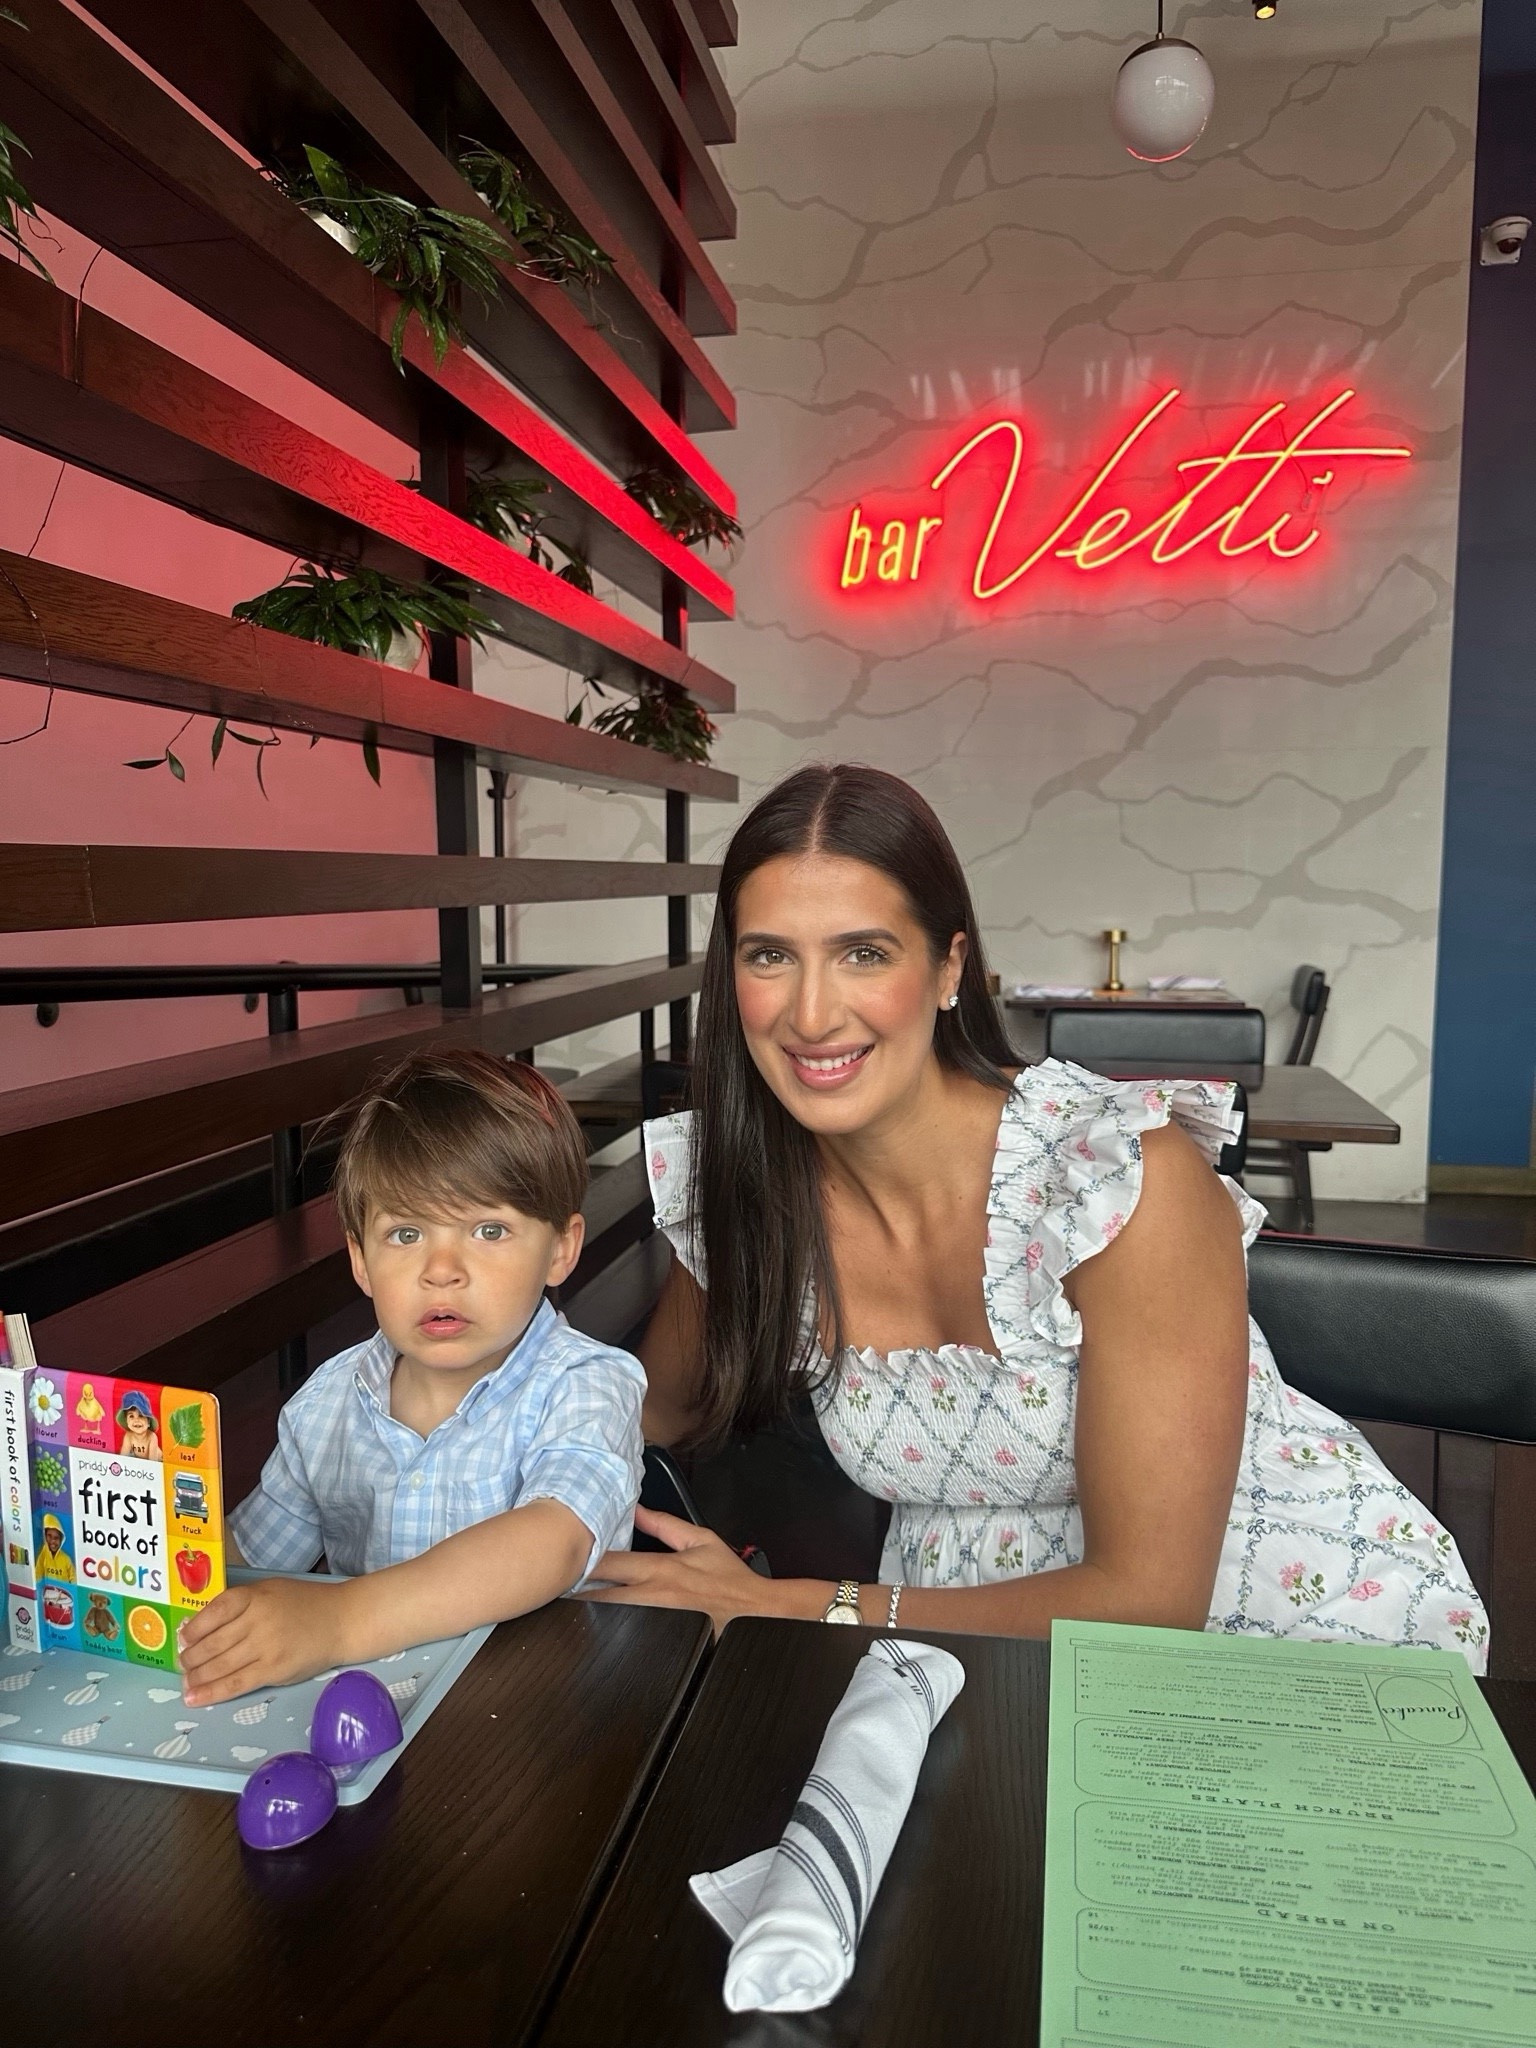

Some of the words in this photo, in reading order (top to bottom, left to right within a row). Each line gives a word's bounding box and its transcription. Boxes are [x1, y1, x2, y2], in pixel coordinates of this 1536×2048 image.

[841, 503, 941, 588] bar
[931, 389, 1411, 599] Vetti
[4, 1389, 16, 1424] first
[6, 1426, 20, 1463] book
[78, 1435, 107, 1448] duckling
[132, 1444, 146, 1453] hat
[180, 1452, 196, 1462] leaf
[9, 1465, 20, 1484] of
[79, 1460, 108, 1476] priddy
[124, 1465, 155, 1480] books
[10, 1486, 22, 1533] colors
[79, 1477, 157, 1527] first
[182, 1524, 202, 1535] truck
[82, 1520, 130, 1551] book
[136, 1534, 158, 1556] of
[46, 1567, 63, 1576] coat
[82, 1556, 162, 1592] colors
[181, 1597, 210, 1607] pepper
[137, 1653, 165, 1665] orange
[1382, 1705, 1460, 1720] Pancakes
[1190, 1794, 1281, 1808] PLATES
[1294, 1804, 1393, 1819] BRUNCH
[1256, 1909, 1346, 1926] BREAD
[1361, 1921, 1395, 1931] ON
[1294, 1994, 1400, 2015] SALADS
